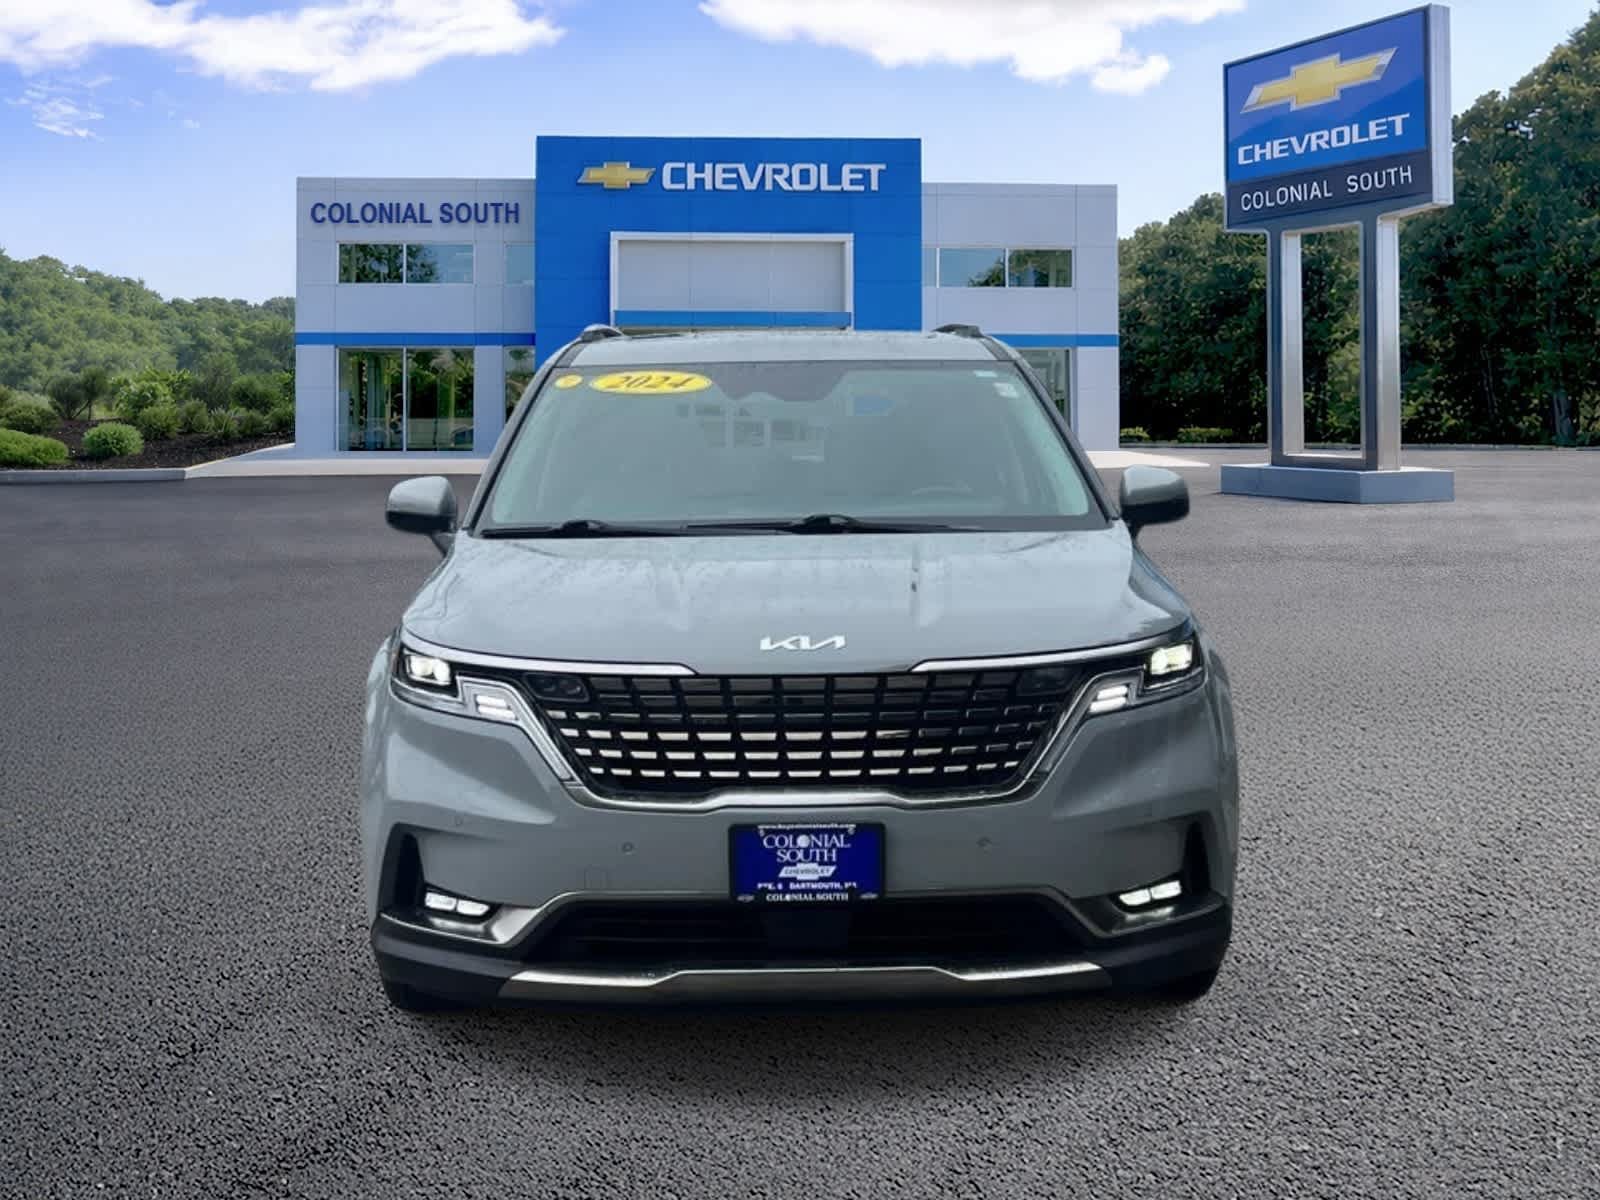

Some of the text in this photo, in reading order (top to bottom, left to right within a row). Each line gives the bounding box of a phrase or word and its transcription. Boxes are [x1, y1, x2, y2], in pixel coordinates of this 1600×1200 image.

[1237, 113, 1410, 165] CHEVROLET
[661, 162, 887, 192] CHEVROLET
[1240, 165, 1413, 212] COLONIAL SOUTH
[310, 202, 520, 225] COLONIAL SOUTH
[605, 374, 696, 390] 2024
[759, 635, 846, 650] KIA
[762, 834, 851, 849] COLONIAL
[776, 849, 838, 863] SOUTH
[784, 867, 831, 876] CHEVROLET
[766, 893, 849, 902] COLONIAL SOUTH
